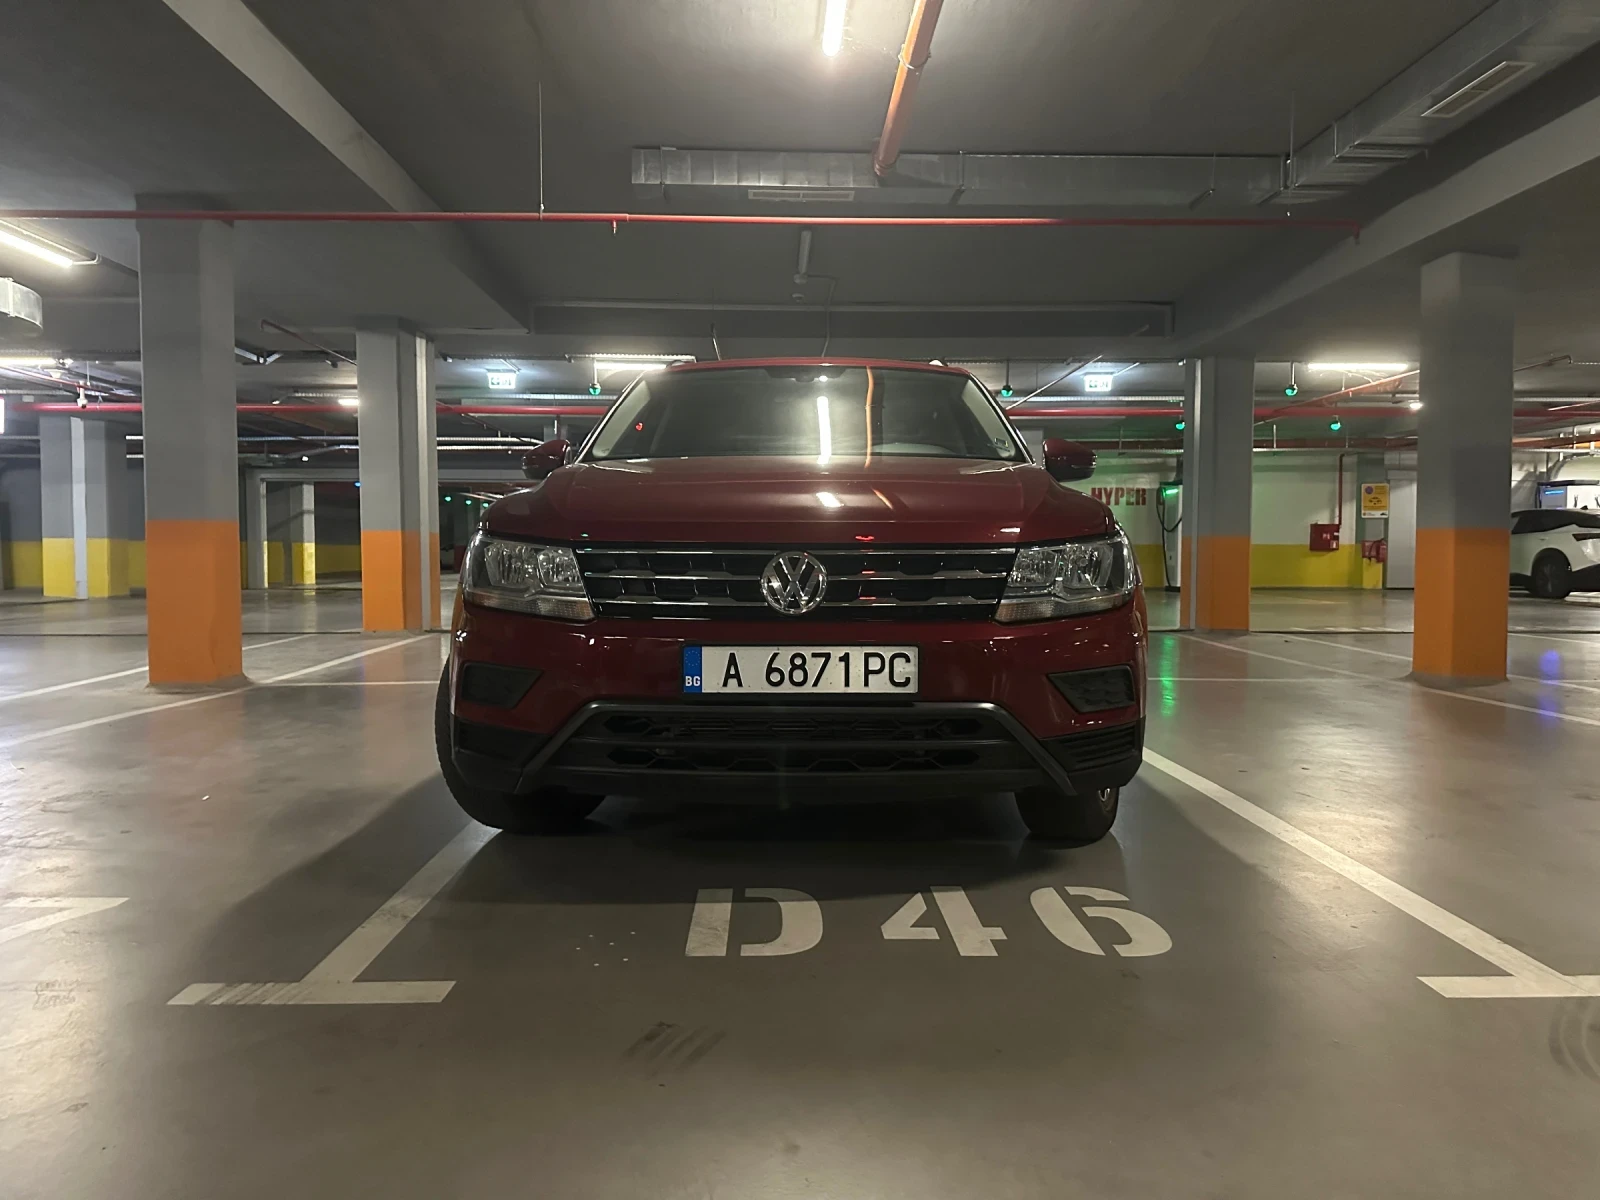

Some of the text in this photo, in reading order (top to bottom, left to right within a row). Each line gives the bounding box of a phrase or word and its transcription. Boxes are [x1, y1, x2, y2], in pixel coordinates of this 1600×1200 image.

[1091, 487, 1147, 506] HYPER
[685, 675, 701, 687] BG
[721, 651, 744, 688] A
[685, 885, 1173, 957] D 46
